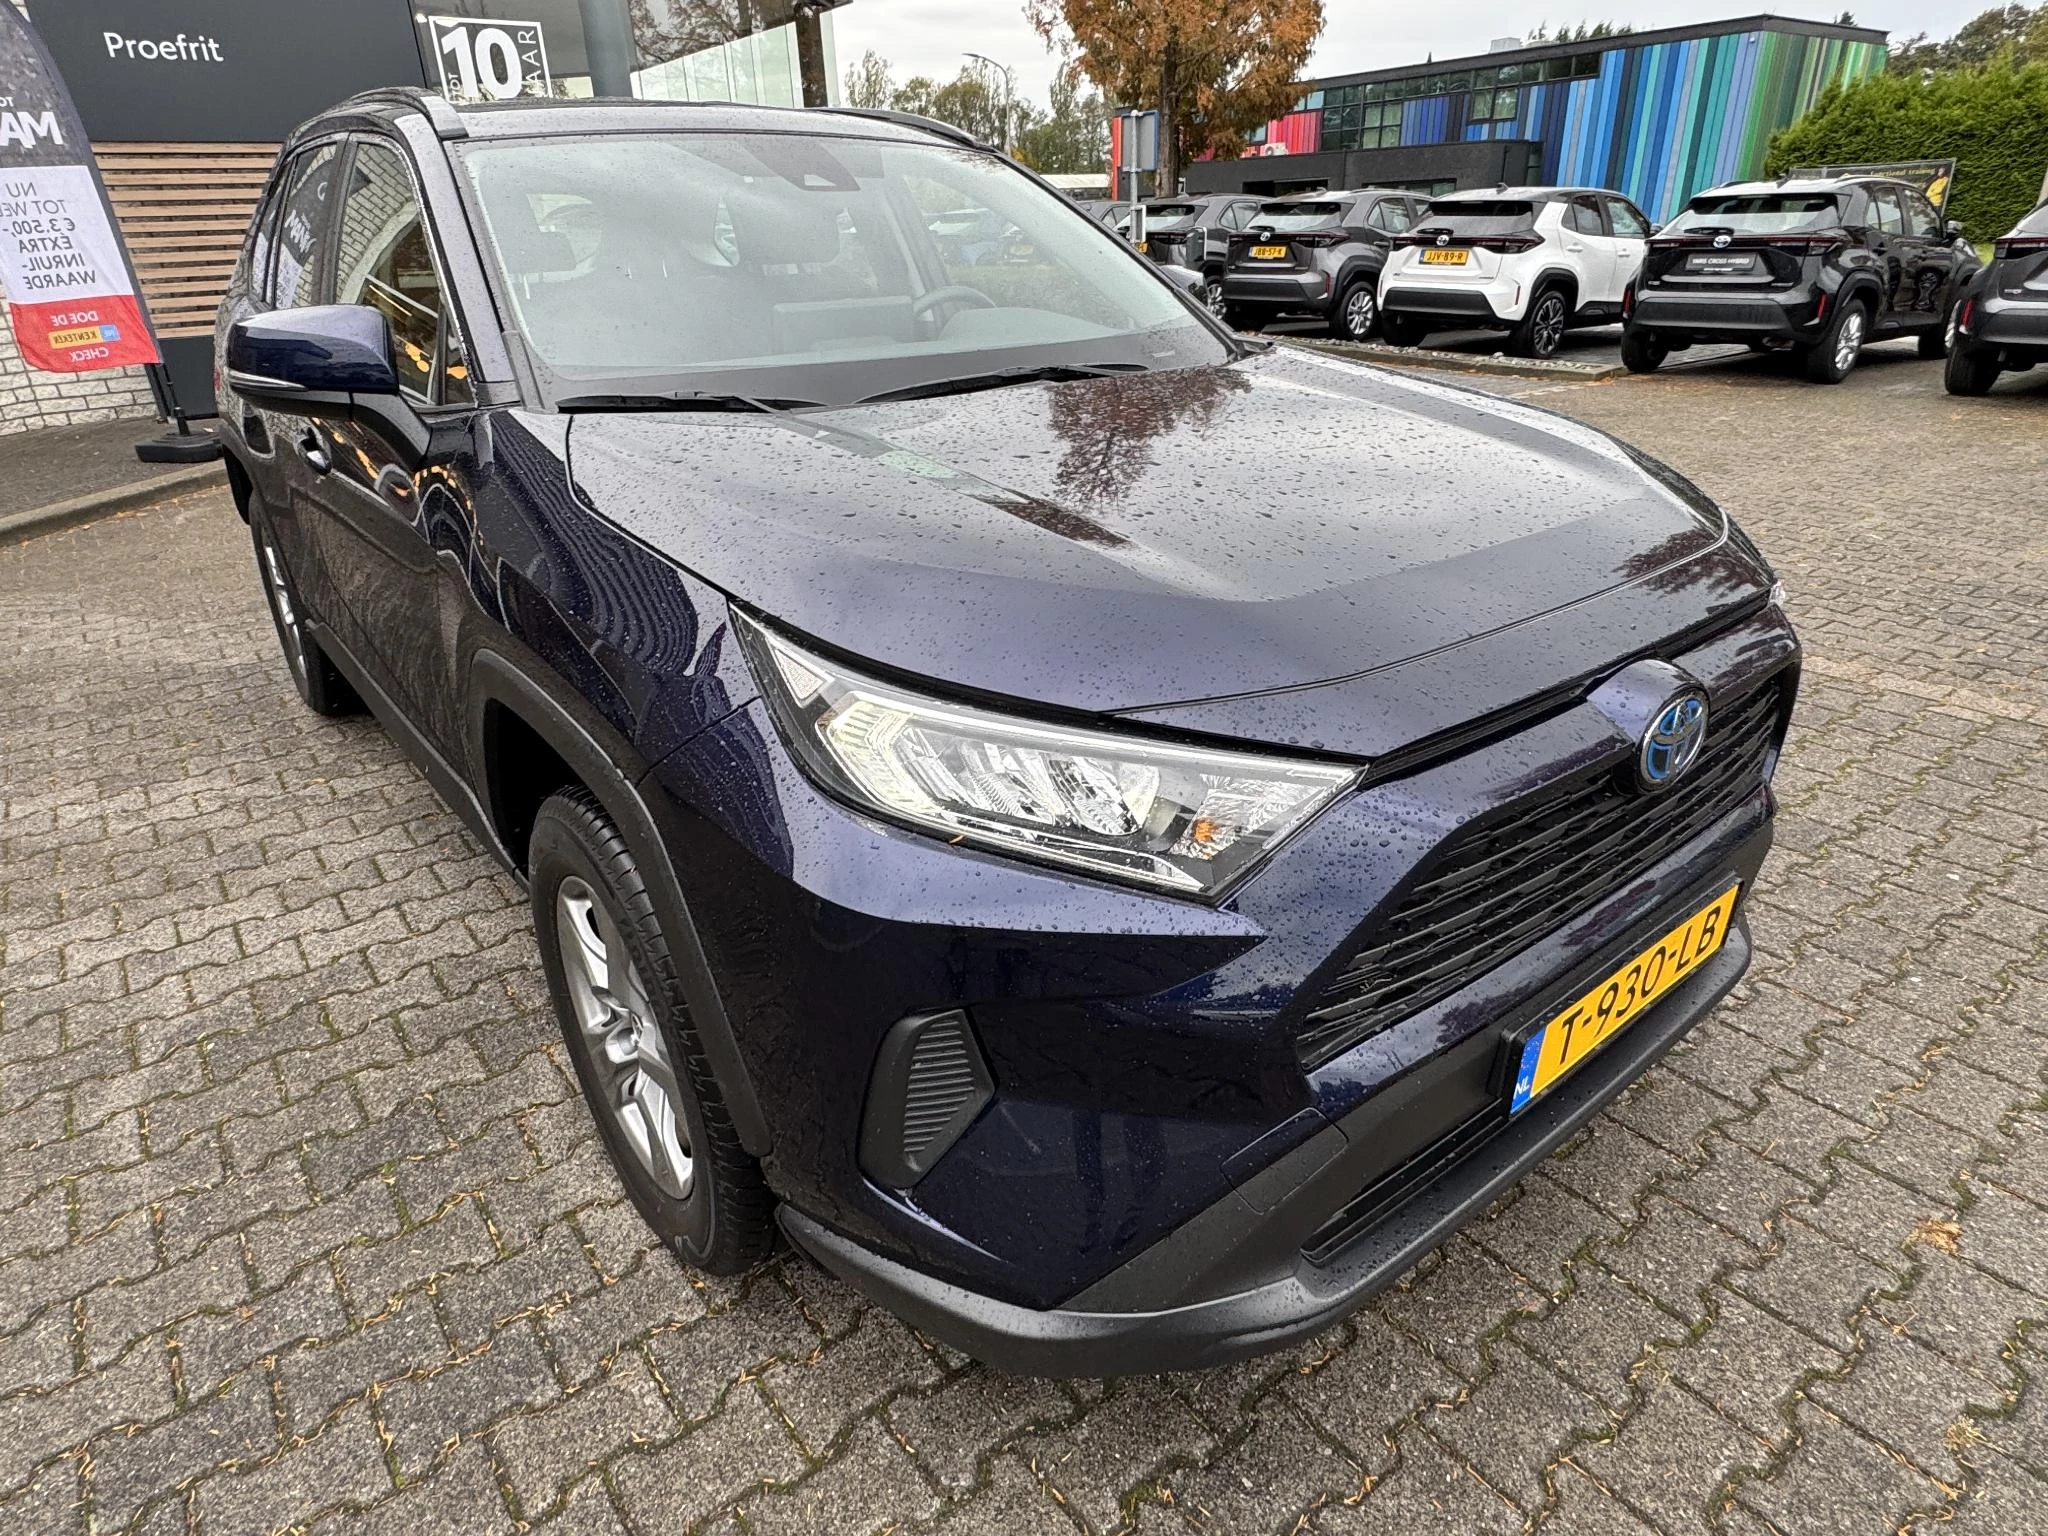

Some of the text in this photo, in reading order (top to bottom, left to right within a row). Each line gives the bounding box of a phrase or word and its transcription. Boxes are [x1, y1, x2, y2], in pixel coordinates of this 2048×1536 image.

[103, 31, 224, 62] Proefrit
[441, 26, 523, 99] 10
[1513, 904, 1722, 1100] NL T-930-LB
